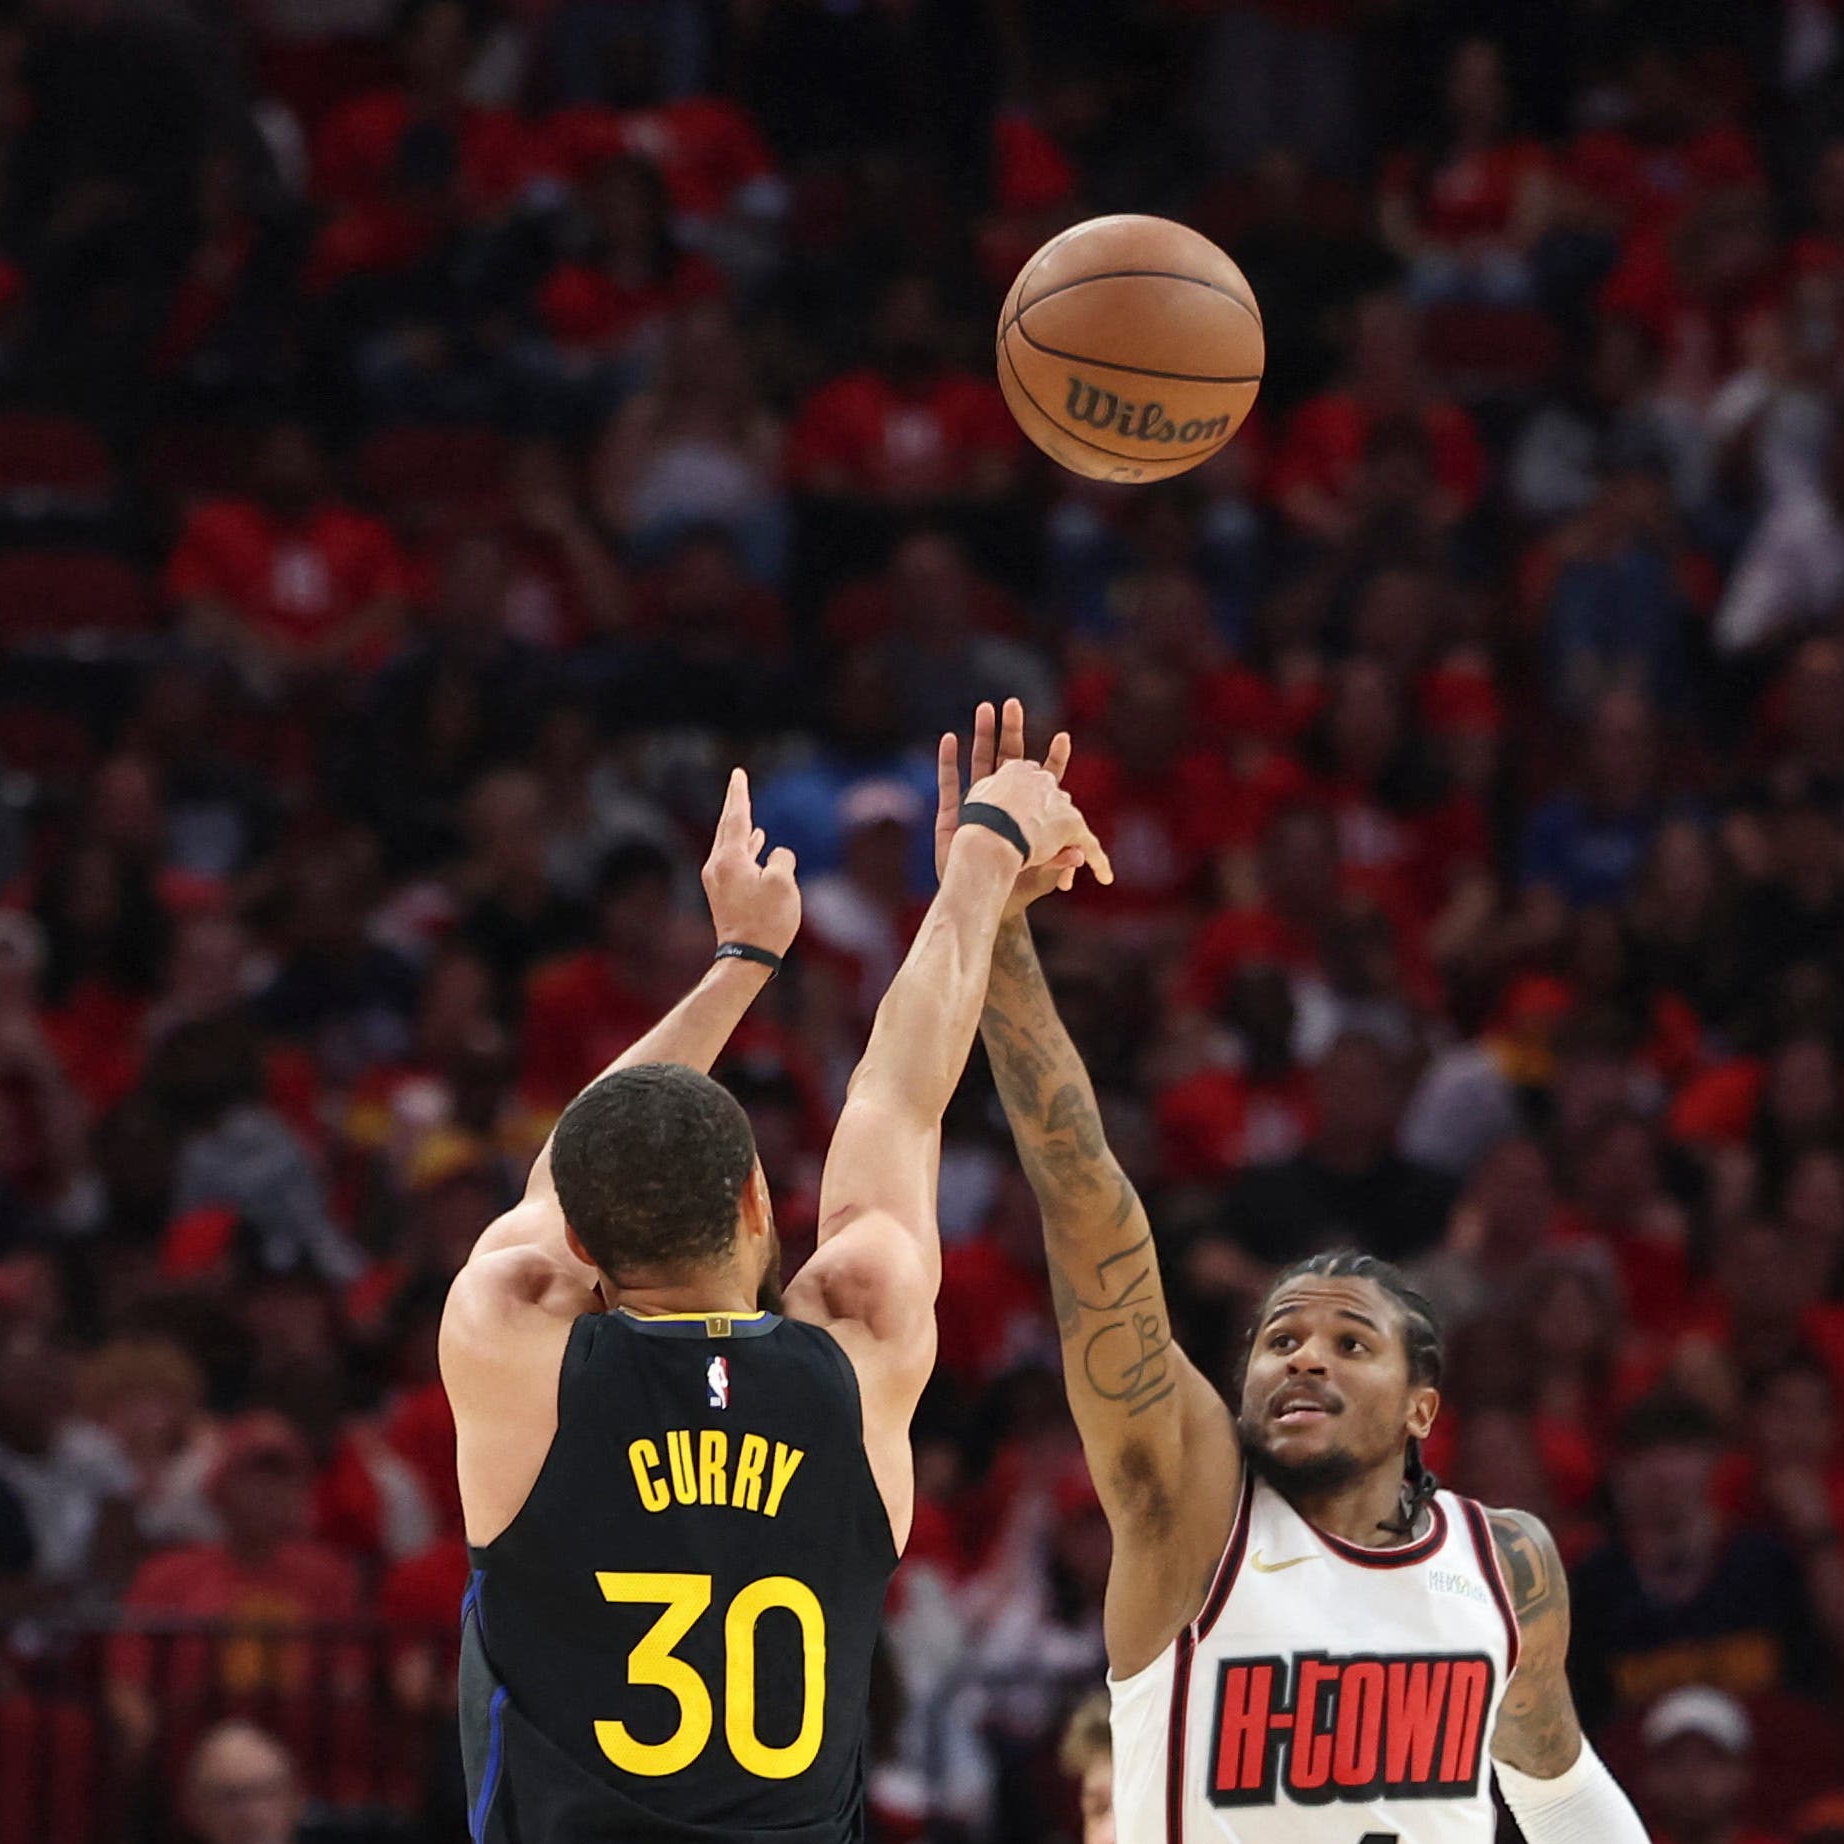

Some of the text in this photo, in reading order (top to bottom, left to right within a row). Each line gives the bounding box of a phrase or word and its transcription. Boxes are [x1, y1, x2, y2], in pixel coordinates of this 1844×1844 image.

[1064, 376, 1231, 446] Wilson
[626, 1429, 806, 1519] CURRY
[592, 1571, 826, 1780] 30
[1209, 1652, 1493, 1806] H-TOWN
